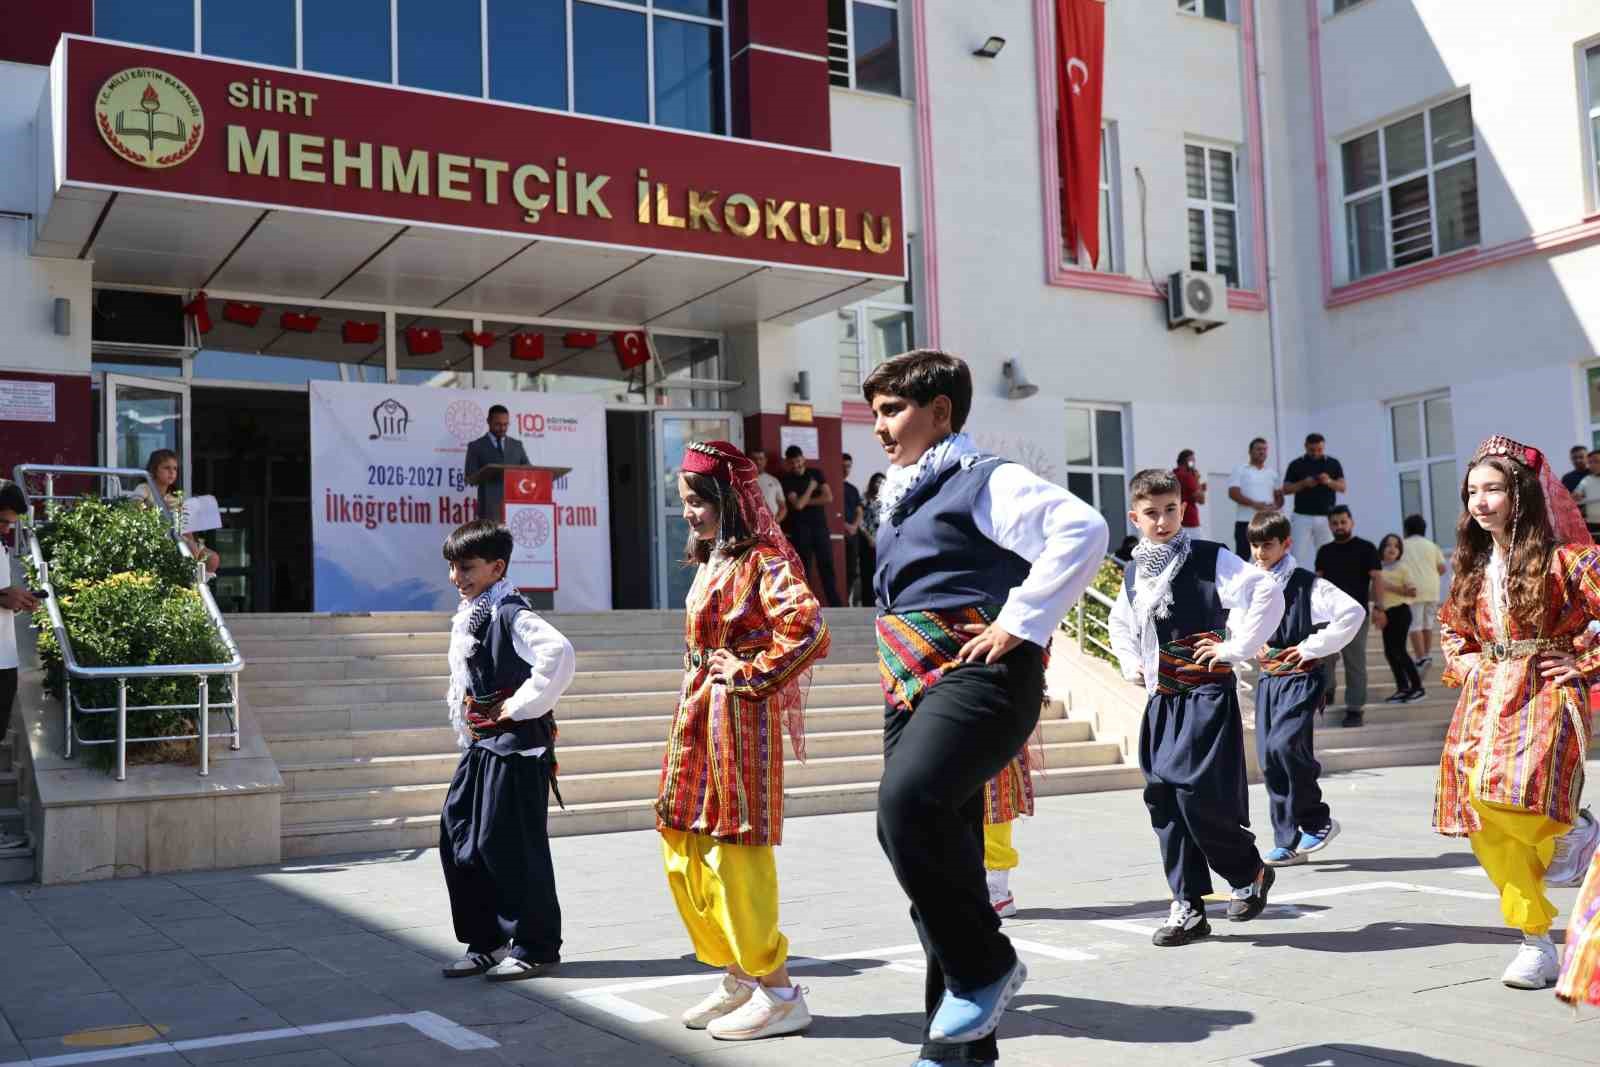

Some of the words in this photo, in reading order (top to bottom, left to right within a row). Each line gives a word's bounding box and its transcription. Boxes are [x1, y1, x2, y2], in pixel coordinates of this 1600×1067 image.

[228, 78, 318, 118] SİİRT
[227, 125, 613, 223] MEHMETÇİK
[637, 168, 893, 255] İLKOKULU
[367, 465, 442, 487] 2026-2027
[326, 489, 431, 529] İlköğretim
